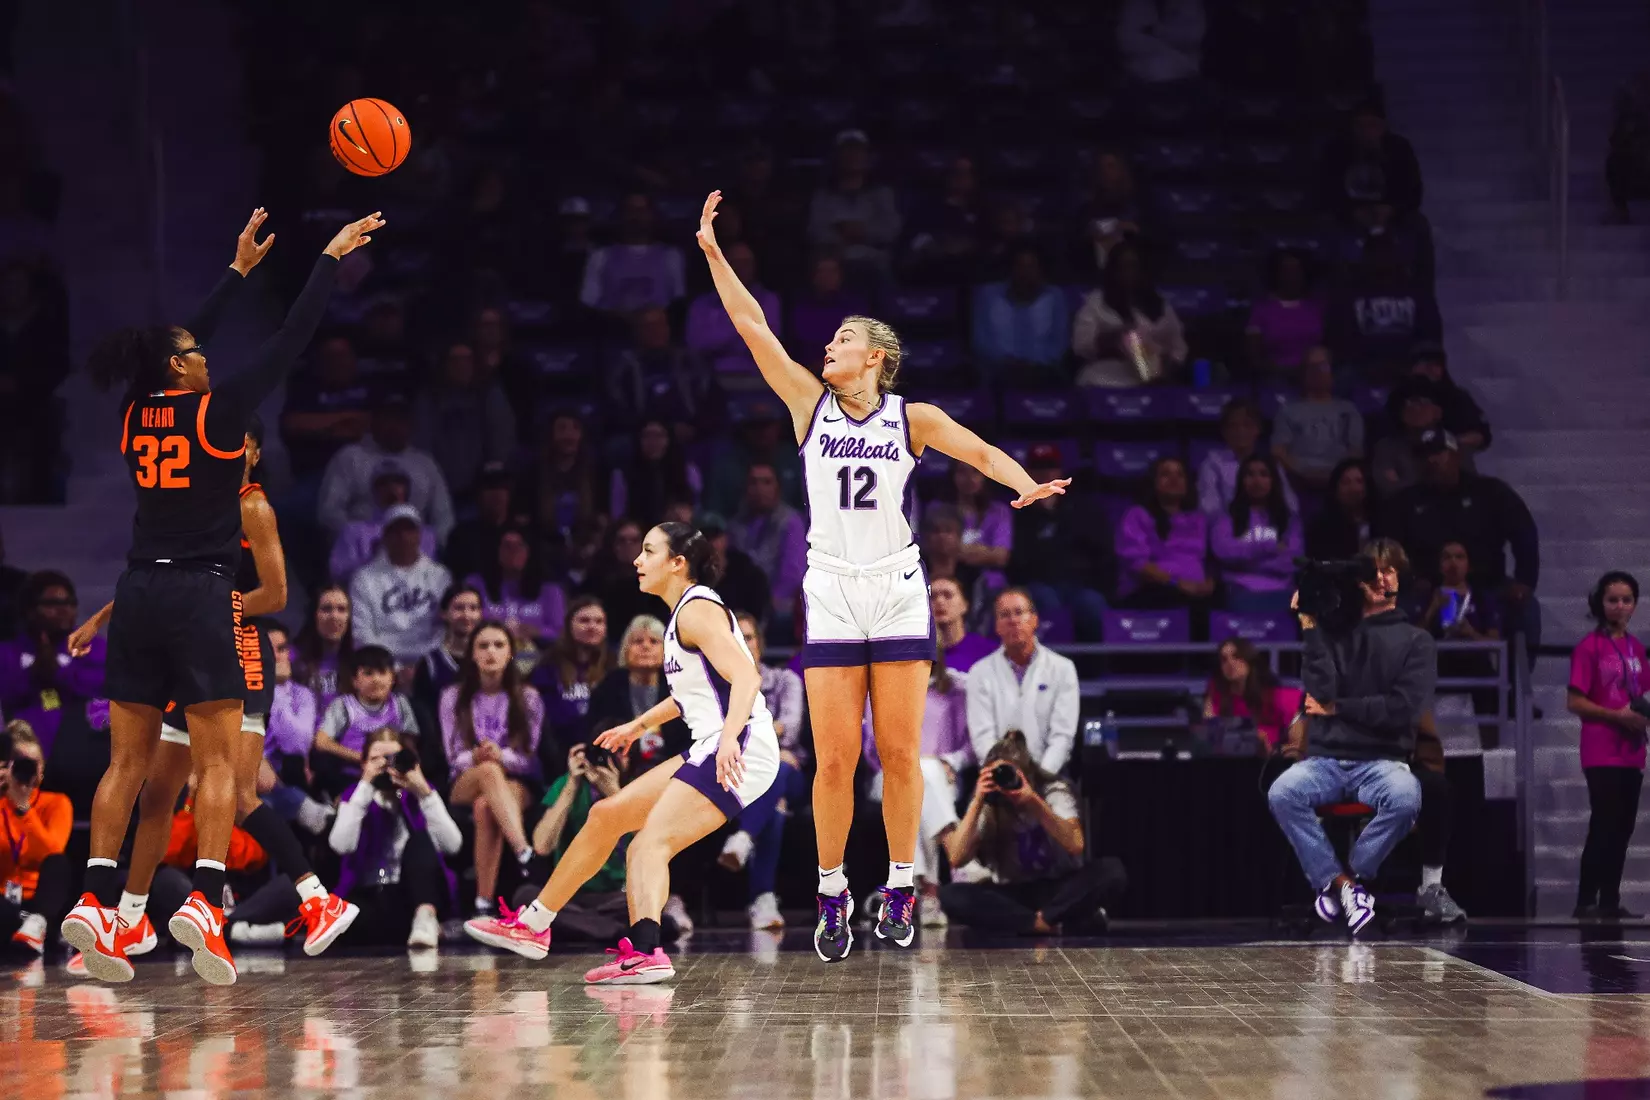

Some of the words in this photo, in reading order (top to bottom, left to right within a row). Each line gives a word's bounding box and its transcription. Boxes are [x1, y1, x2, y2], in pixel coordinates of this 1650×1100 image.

[142, 406, 175, 428] HEARD
[132, 435, 191, 489] 32
[819, 433, 900, 462] Wildcats
[836, 465, 878, 511] 12
[241, 624, 265, 691] COWGIRLS
